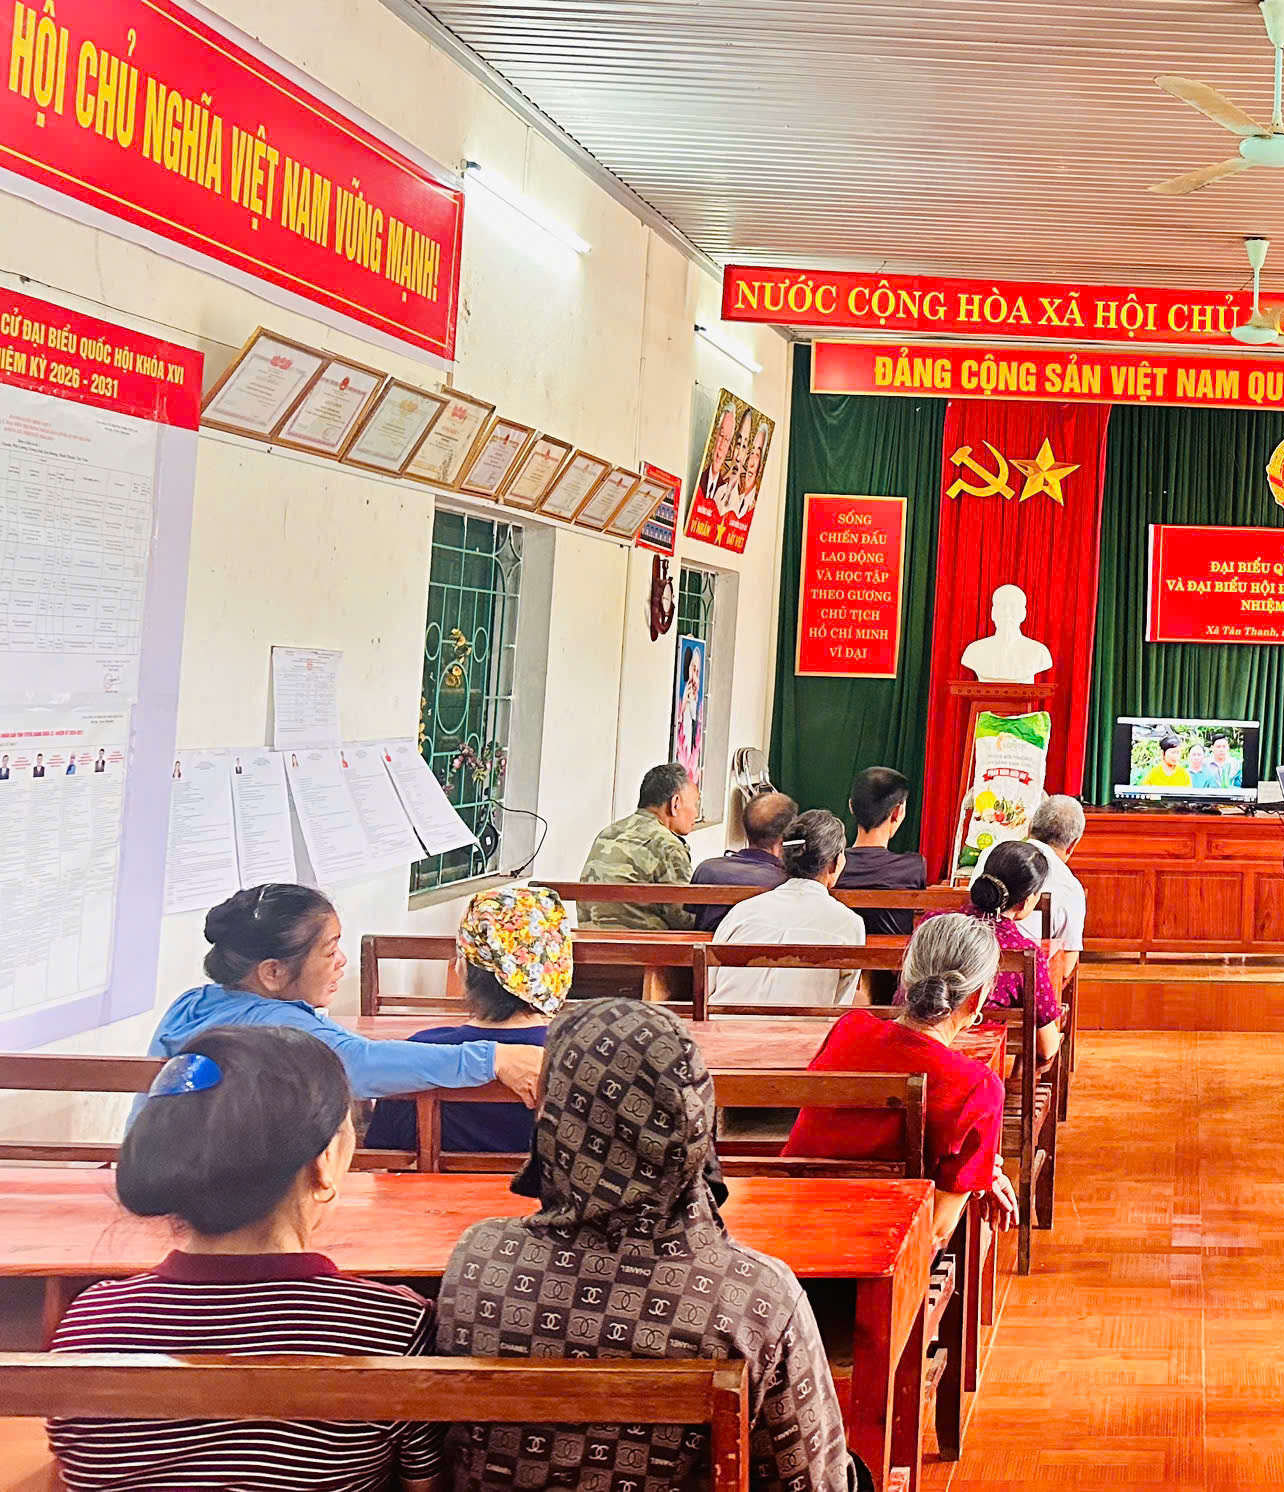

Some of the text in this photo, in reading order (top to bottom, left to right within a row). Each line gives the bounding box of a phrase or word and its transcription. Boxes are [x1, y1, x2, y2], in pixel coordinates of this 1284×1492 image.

[8, 0, 441, 302] HỘI CHỦ NGHĨA VIỆT NAM VỮNG MẠNH!
[734, 276, 838, 314] NƯỚC
[848, 280, 945, 327] CỘNG
[956, 286, 1030, 324] HÒA
[1037, 292, 1085, 328] XÃ
[1094, 294, 1156, 338] HỘI
[1168, 295, 1240, 333] CHỦ
[1, 307, 185, 385] CỬ ĐẠI BIỂU QUỐC HỘI KHÓA XVI
[0, 345, 27, 376] IỆM
[29, 353, 48, 380] KỲ
[49, 362, 80, 388] 2026
[90, 374, 119, 399] 2031
[874, 348, 951, 388] ĐẢNG
[961, 354, 1036, 396] CỘNG
[1045, 356, 1101, 394] SẢN
[1111, 361, 1167, 401] VIỆT
[1176, 368, 1239, 400] NAM
[838, 510, 872, 525] SỐNG
[819, 530, 887, 545] CHIẾN ĐẤU
[821, 550, 884, 566] LAO ĐỘNG
[1210, 561, 1234, 575] ĐẠI
[1237, 556, 1271, 574] BIỂU
[836, 571, 863, 585] HỌC
[864, 570, 889, 584] TẬP
[1166, 577, 1185, 591] VÀ
[1187, 580, 1211, 595] ĐẠI
[1214, 576, 1248, 593] BIỂU
[1251, 580, 1276, 597] HỘI
[811, 589, 892, 602] THEO GƯƠNG
[820, 606, 881, 622] CHỦ TỊCH
[830, 625, 853, 639] CHÍ
[855, 629, 889, 641] MINH
[845, 649, 867, 661] ĐẠI
